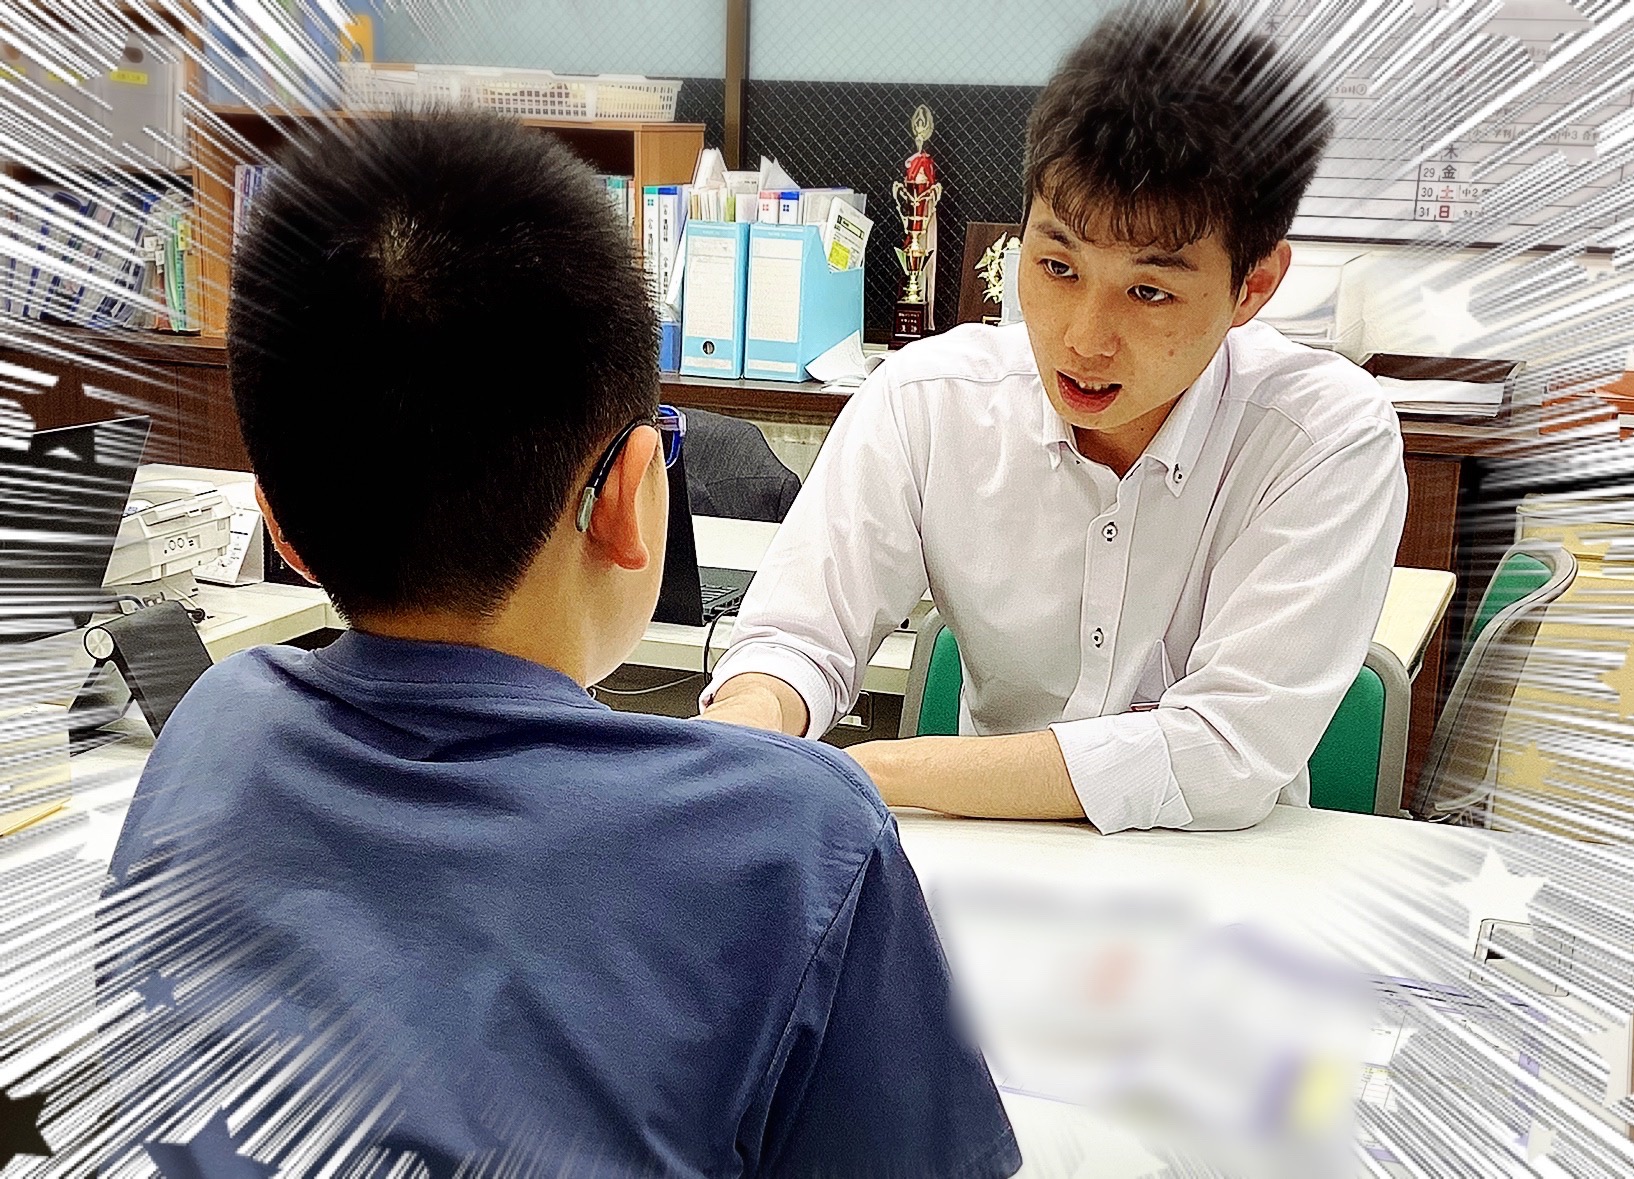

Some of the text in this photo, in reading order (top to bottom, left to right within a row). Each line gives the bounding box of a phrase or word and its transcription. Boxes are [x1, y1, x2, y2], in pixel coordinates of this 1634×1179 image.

[1444, 144, 1459, 160] 木
[1423, 164, 1457, 180] 29 金
[1421, 187, 1433, 197] 30
[1439, 185, 1454, 200] 土
[1418, 206, 1430, 218] 31
[1439, 205, 1450, 219] 日
